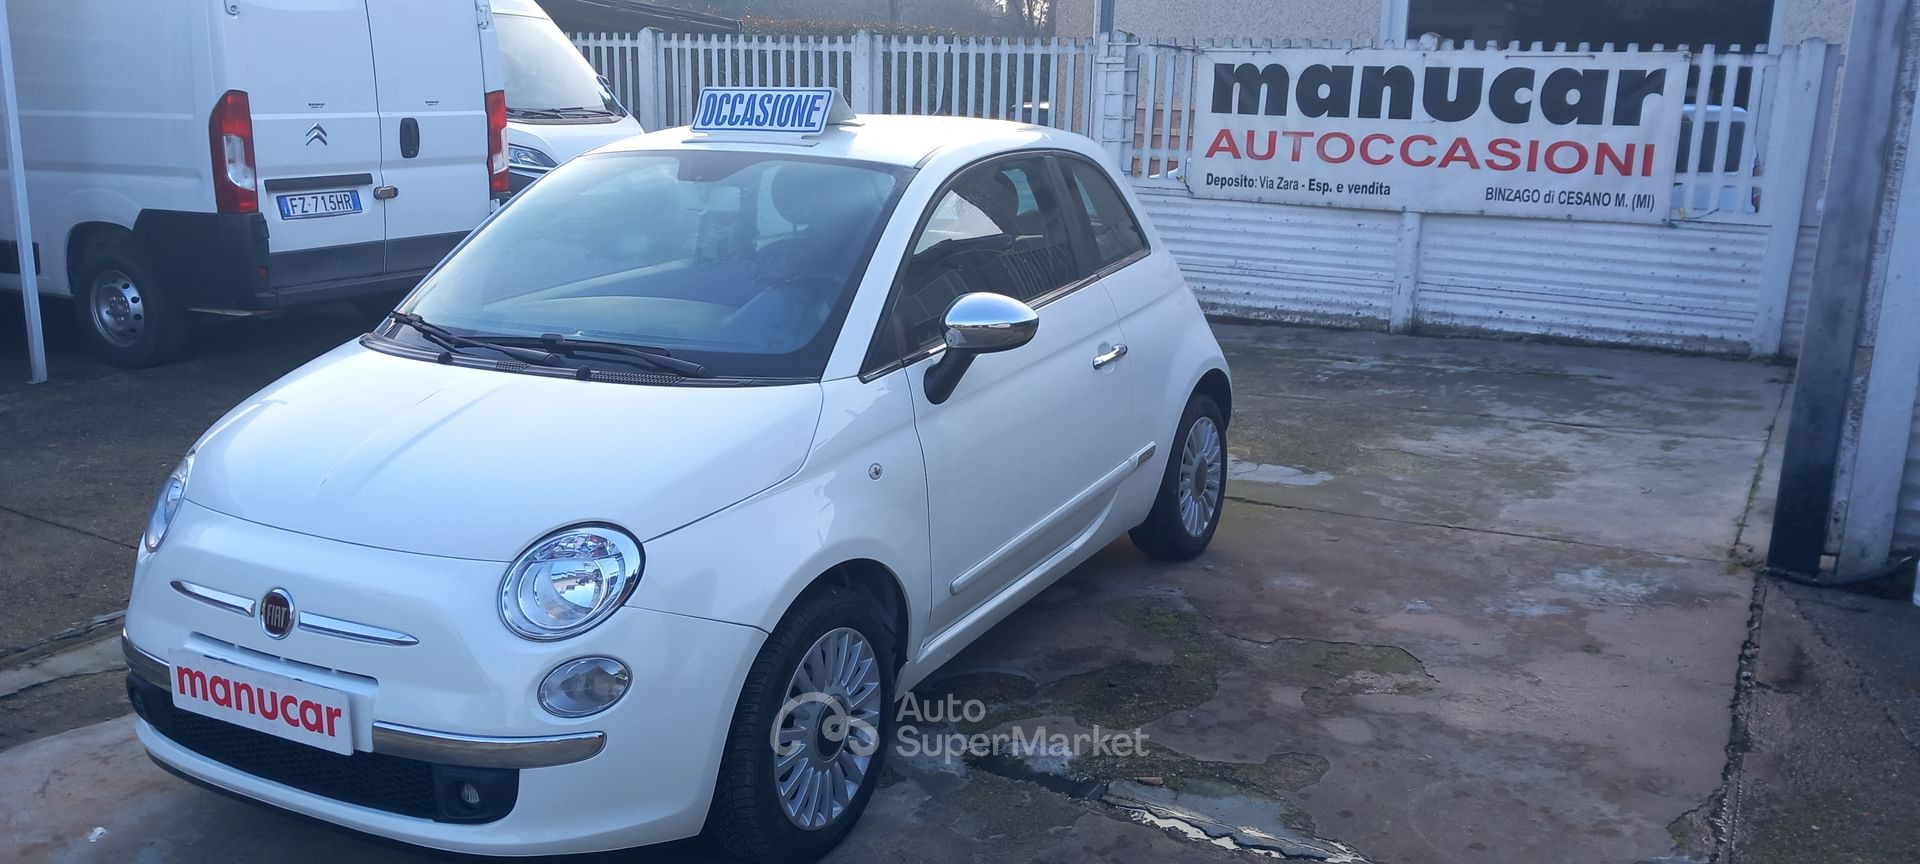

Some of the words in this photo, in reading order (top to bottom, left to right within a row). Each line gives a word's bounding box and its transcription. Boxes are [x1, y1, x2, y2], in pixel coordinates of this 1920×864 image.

[700, 93, 825, 128] OCCASIONE
[1211, 63, 1667, 126] manucar
[1204, 128, 1656, 177] AUTOCCASIONI
[1205, 172, 1257, 191] Deposito:
[1259, 175, 1275, 190] Via
[1276, 176, 1299, 191] Zara
[1308, 178, 1332, 196] Esp.
[1336, 182, 1344, 193] e
[1347, 181, 1391, 196] vendita
[1485, 186, 1540, 204] BINZAGO
[1543, 190, 1554, 204] di
[1558, 190, 1611, 208] CESANO
[1614, 192, 1628, 209] M.
[1631, 193, 1655, 212] (MI)
[266, 603, 287, 628] FIAT
[176, 665, 342, 737] manucar
